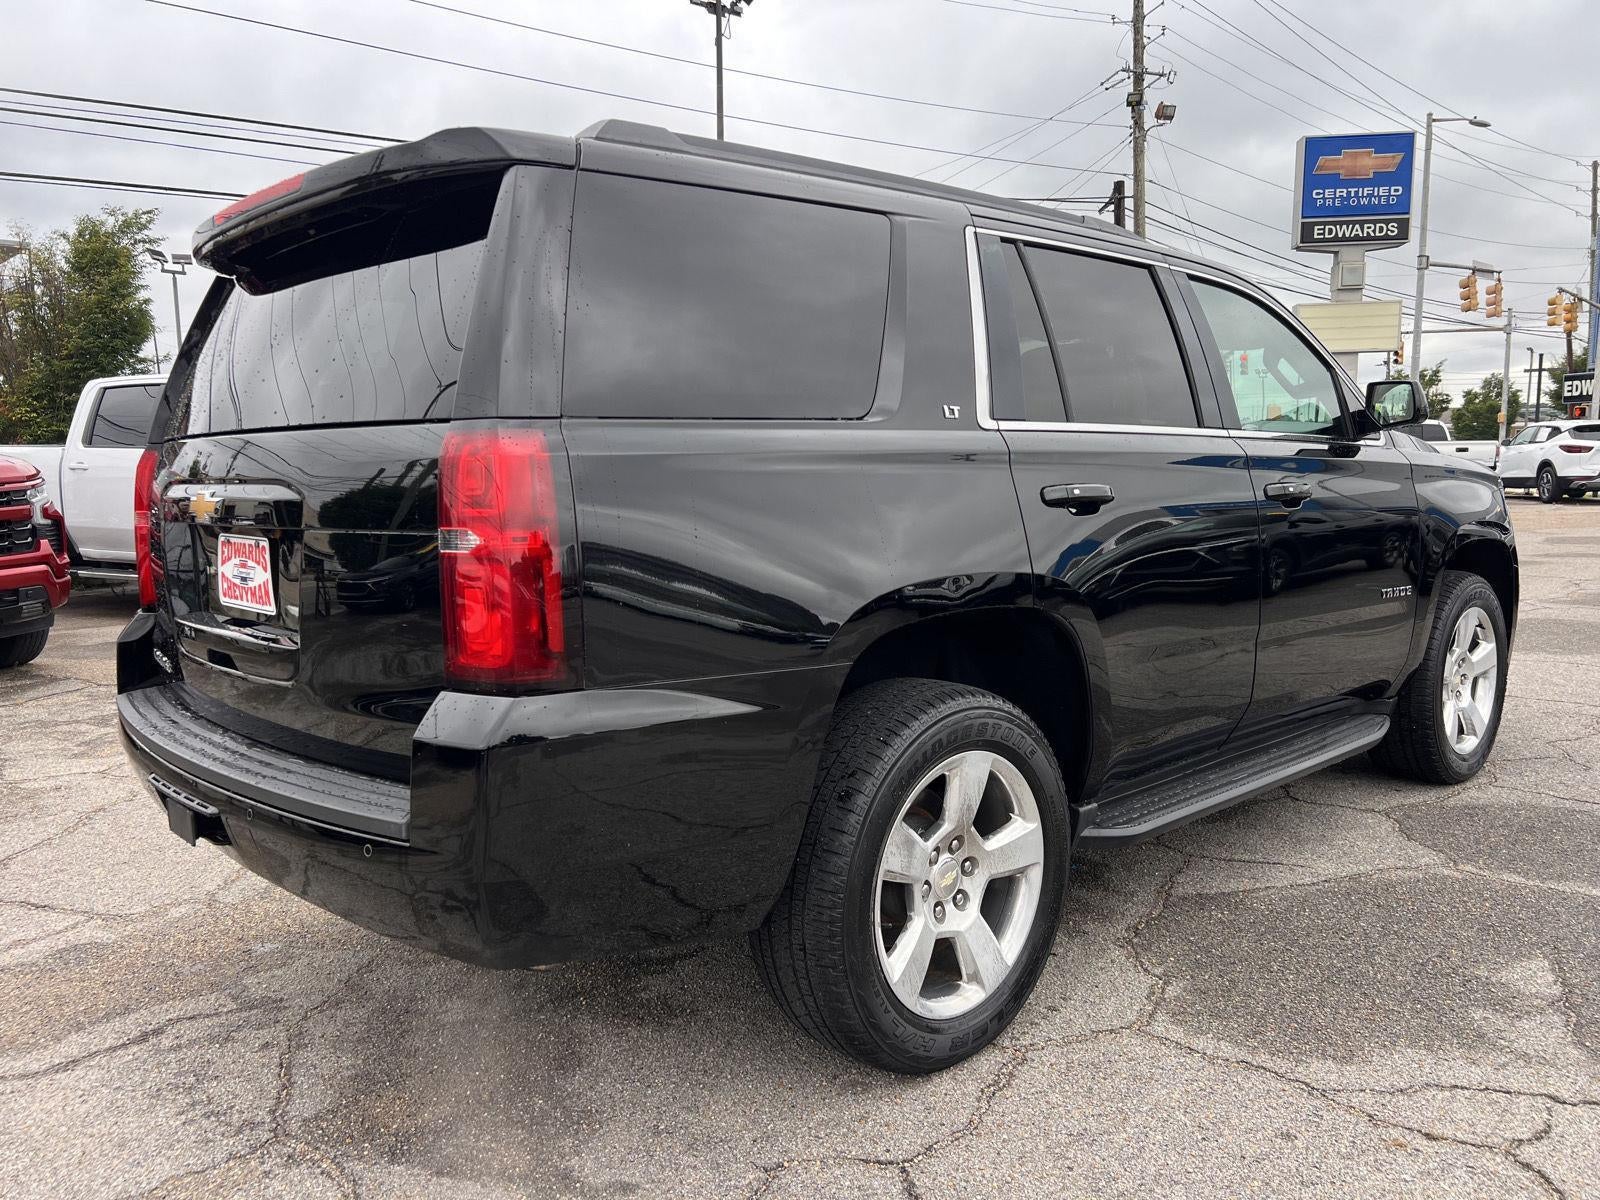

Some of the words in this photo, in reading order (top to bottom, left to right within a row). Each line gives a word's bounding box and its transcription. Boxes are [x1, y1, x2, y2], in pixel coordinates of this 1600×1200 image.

[1312, 186, 1403, 199] CERTIFIED
[1316, 197, 1397, 207] PRE-OWNED
[1313, 223, 1398, 239] EDWARDS
[942, 404, 961, 419] LT
[221, 540, 268, 574] EDWARDS
[221, 571, 272, 607] CHEVYMAN
